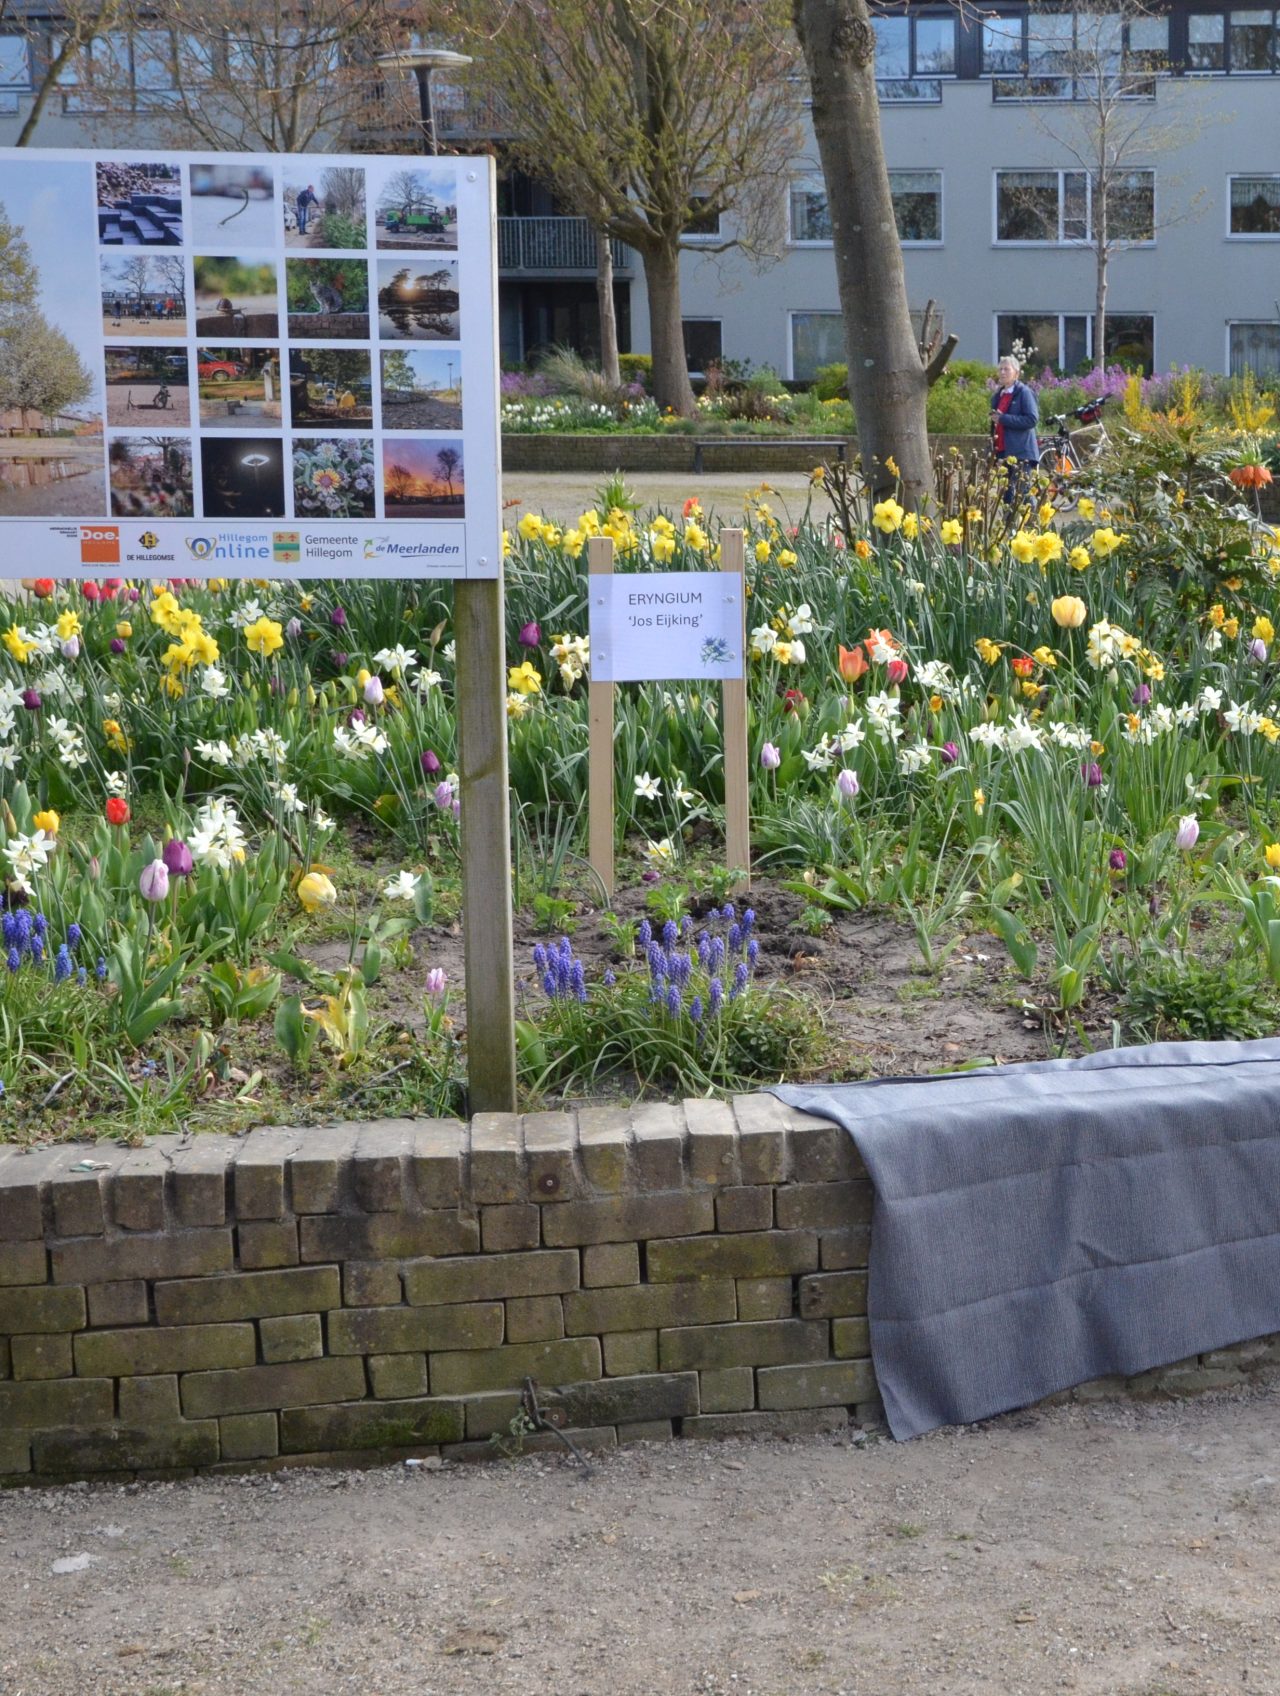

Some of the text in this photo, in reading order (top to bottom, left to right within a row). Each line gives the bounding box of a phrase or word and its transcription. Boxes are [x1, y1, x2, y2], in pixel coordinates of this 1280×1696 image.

[218, 534, 268, 543] Hillegom
[305, 535, 358, 545] Gemeente
[306, 548, 353, 559] Hillegom
[386, 544, 459, 554] Meerlanden
[628, 592, 702, 605] ERYNGIUM
